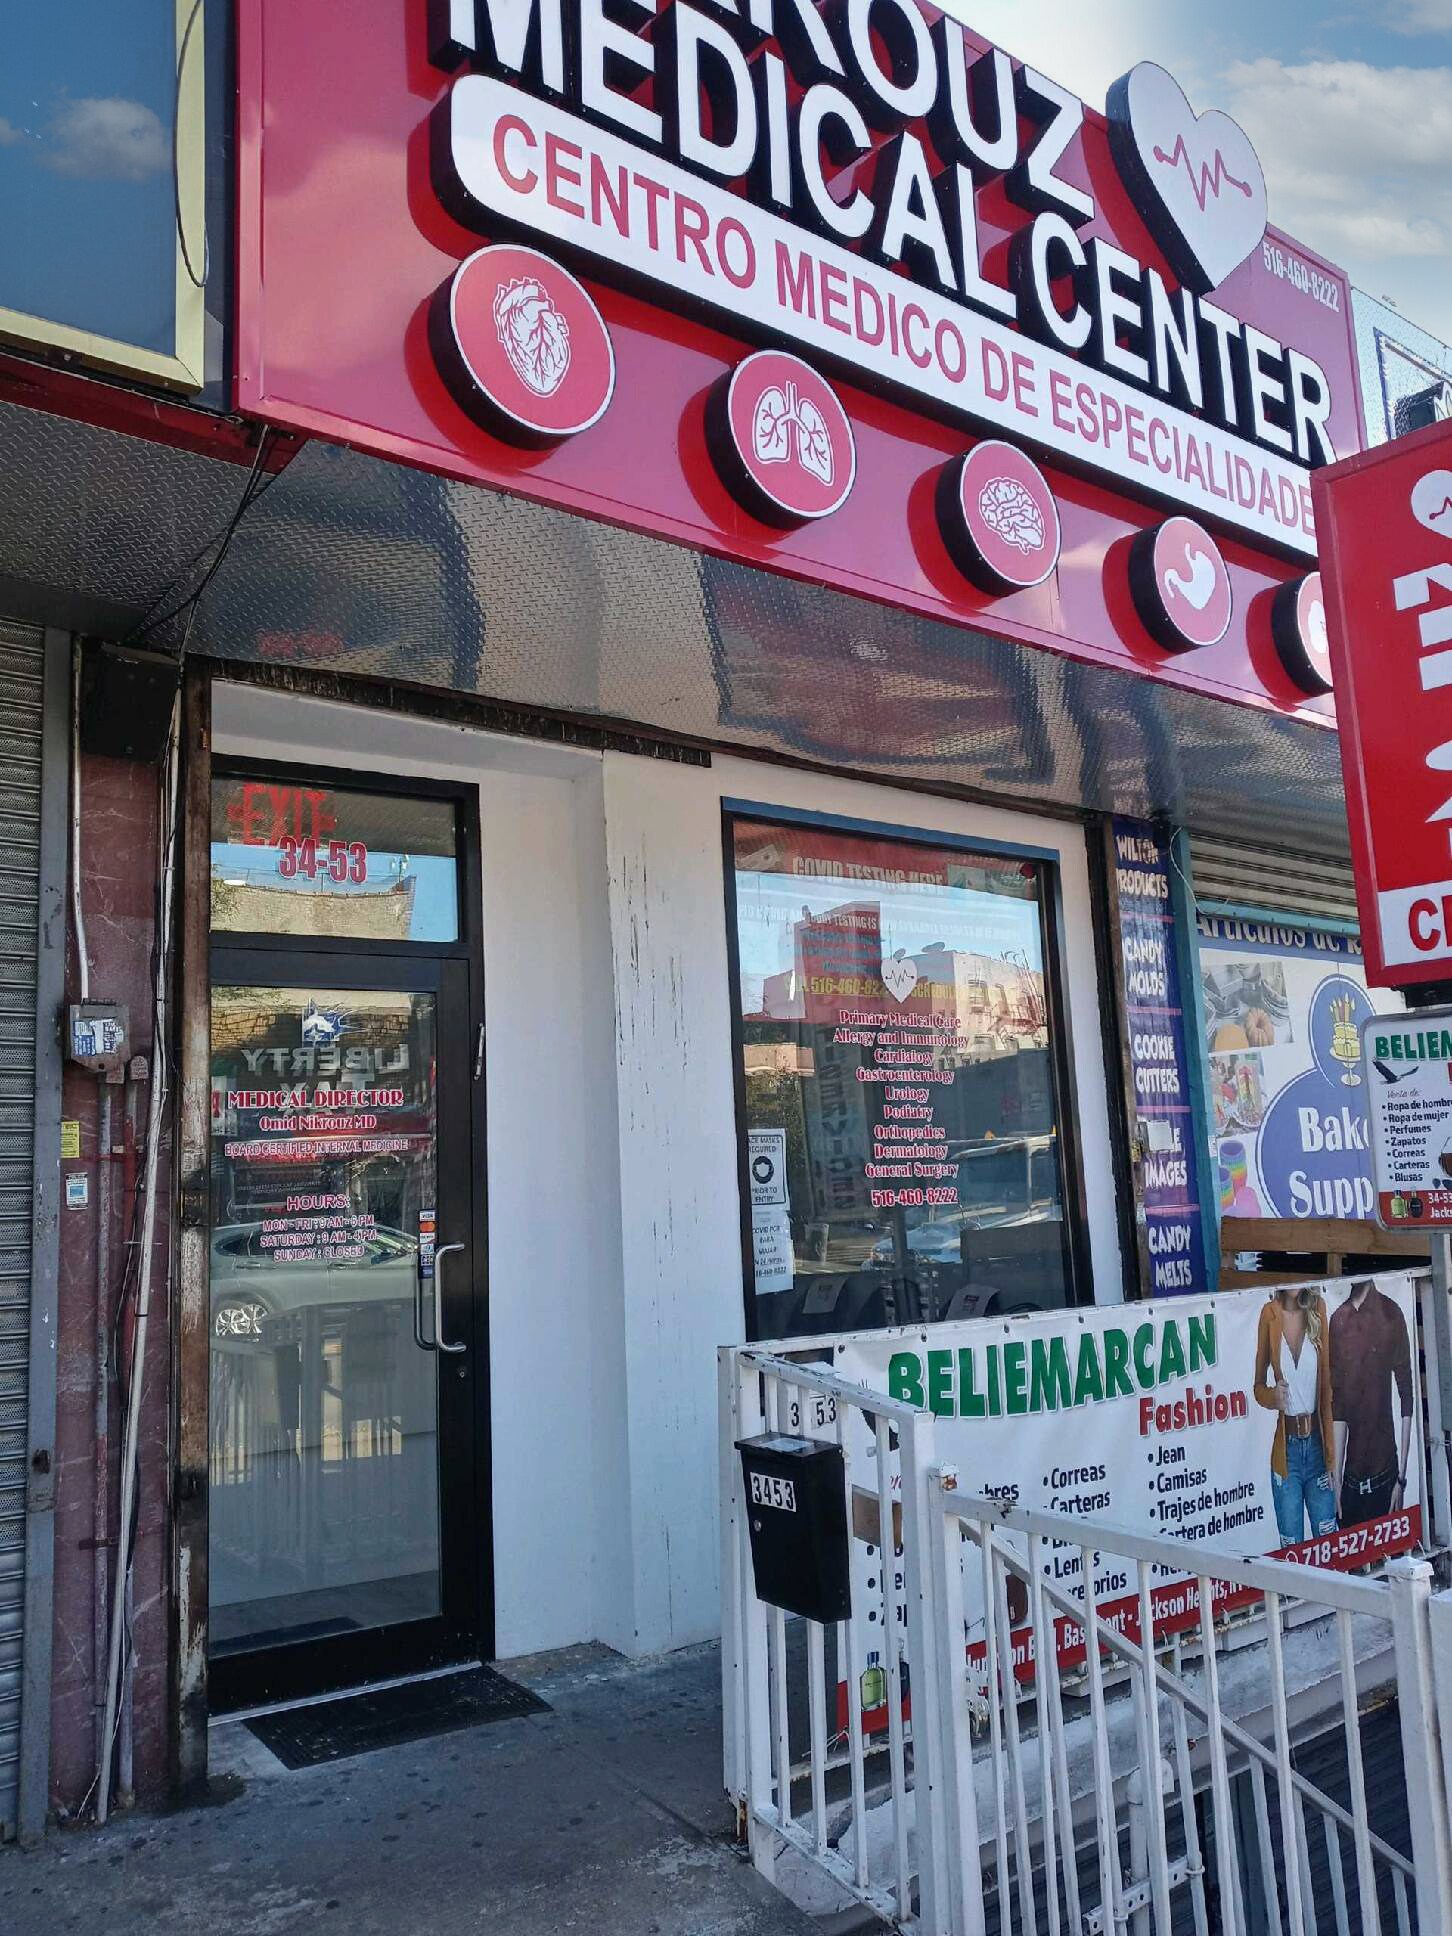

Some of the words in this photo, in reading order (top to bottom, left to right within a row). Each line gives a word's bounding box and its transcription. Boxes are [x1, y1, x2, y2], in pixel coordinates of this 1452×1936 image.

[493, 114, 757, 290] CENTRO
[775, 238, 967, 384] MEDICO
[981, 336, 1040, 417] DE
[1263, 240, 1340, 314] 516-460-8222
[1031, 211, 1338, 466] CENTER
[278, 836, 368, 884] 34-53
[1122, 937, 1165, 965] CANDY
[811, 976, 889, 996] 516-460-82
[1129, 971, 1166, 997] MOLDS
[840, 1010, 888, 1028] Primary
[889, 1012, 933, 1027] Medical
[933, 1013, 961, 1028] Care
[833, 1028, 876, 1046] Allergy
[878, 1031, 899, 1045] and
[901, 1031, 968, 1048] Immunology
[1133, 1034, 1175, 1061] COOKIE
[874, 1049, 935, 1066] Cardiology
[856, 1066, 954, 1084] Gastroenterology
[1136, 1066, 1180, 1095] CUTTERS
[228, 1090, 312, 1108] MEDICAL
[314, 1089, 404, 1108] DIRECTOR
[885, 1086, 930, 1103] Urology
[884, 1105, 933, 1121] Podiatry
[1388, 1102, 1409, 1112] Ropa
[1410, 1100, 1421, 1110] de
[259, 1115, 296, 1131] Omid
[299, 1115, 353, 1130] Nikrouz
[354, 1114, 377, 1130] MD
[1388, 1113, 1411, 1123] Ropa
[1412, 1112, 1424, 1122] de
[1425, 1111, 1449, 1124] mujer
[874, 1124, 945, 1142] Orthopedics
[1390, 1124, 1432, 1134] Perfumes
[225, 1142, 261, 1156] BOARD
[362, 1138, 409, 1152] MEDICINE
[874, 1143, 948, 1160] Dermatology
[1391, 1137, 1426, 1148] Zapatos
[1392, 1149, 1426, 1158] Correas
[865, 1163, 911, 1178] General
[913, 1162, 959, 1179] Surgery
[1145, 1161, 1188, 1188] IMAGES
[1394, 1160, 1430, 1169] Carteras
[1394, 1172, 1423, 1182] Blusas
[871, 1187, 958, 1207] 516-460-8222
[1289, 1169, 1375, 1220] Supp
[262, 1219, 288, 1232] MON
[295, 1218, 313, 1231] FRI
[327, 1216, 344, 1228] AM
[358, 1215, 375, 1226] PM
[260, 1233, 316, 1248] SATURDAY
[330, 1231, 346, 1244] AM
[360, 1229, 377, 1241] PM
[1149, 1225, 1192, 1254] CANDY
[274, 1248, 316, 1262] SUNDAY
[323, 1246, 364, 1258] CLOSED
[1155, 1259, 1193, 1289] MELTS
[888, 1313, 1217, 1418] BELIEMARCAN
[790, 1397, 837, 1427] 353
[1139, 1384, 1247, 1437] Fashion
[1156, 1446, 1186, 1466] Jean
[1051, 1464, 1106, 1489] Correas
[1157, 1468, 1207, 1493] Camisas
[752, 1475, 794, 1510] 3453
[1050, 1491, 1110, 1514] Carteras
[1157, 1497, 1197, 1523] Trajes
[1197, 1491, 1213, 1512] de
[1214, 1481, 1255, 1507] hombre
[1160, 1525, 1206, 1541] tera
[1207, 1516, 1222, 1536] de
[1223, 1505, 1264, 1531] hombre
[1302, 1515, 1410, 1566] 718-527-2733
[1053, 1551, 1100, 1579] Lents
[1064, 1609, 1126, 1650] Basent
[1135, 1595, 1185, 1627] Jckson
